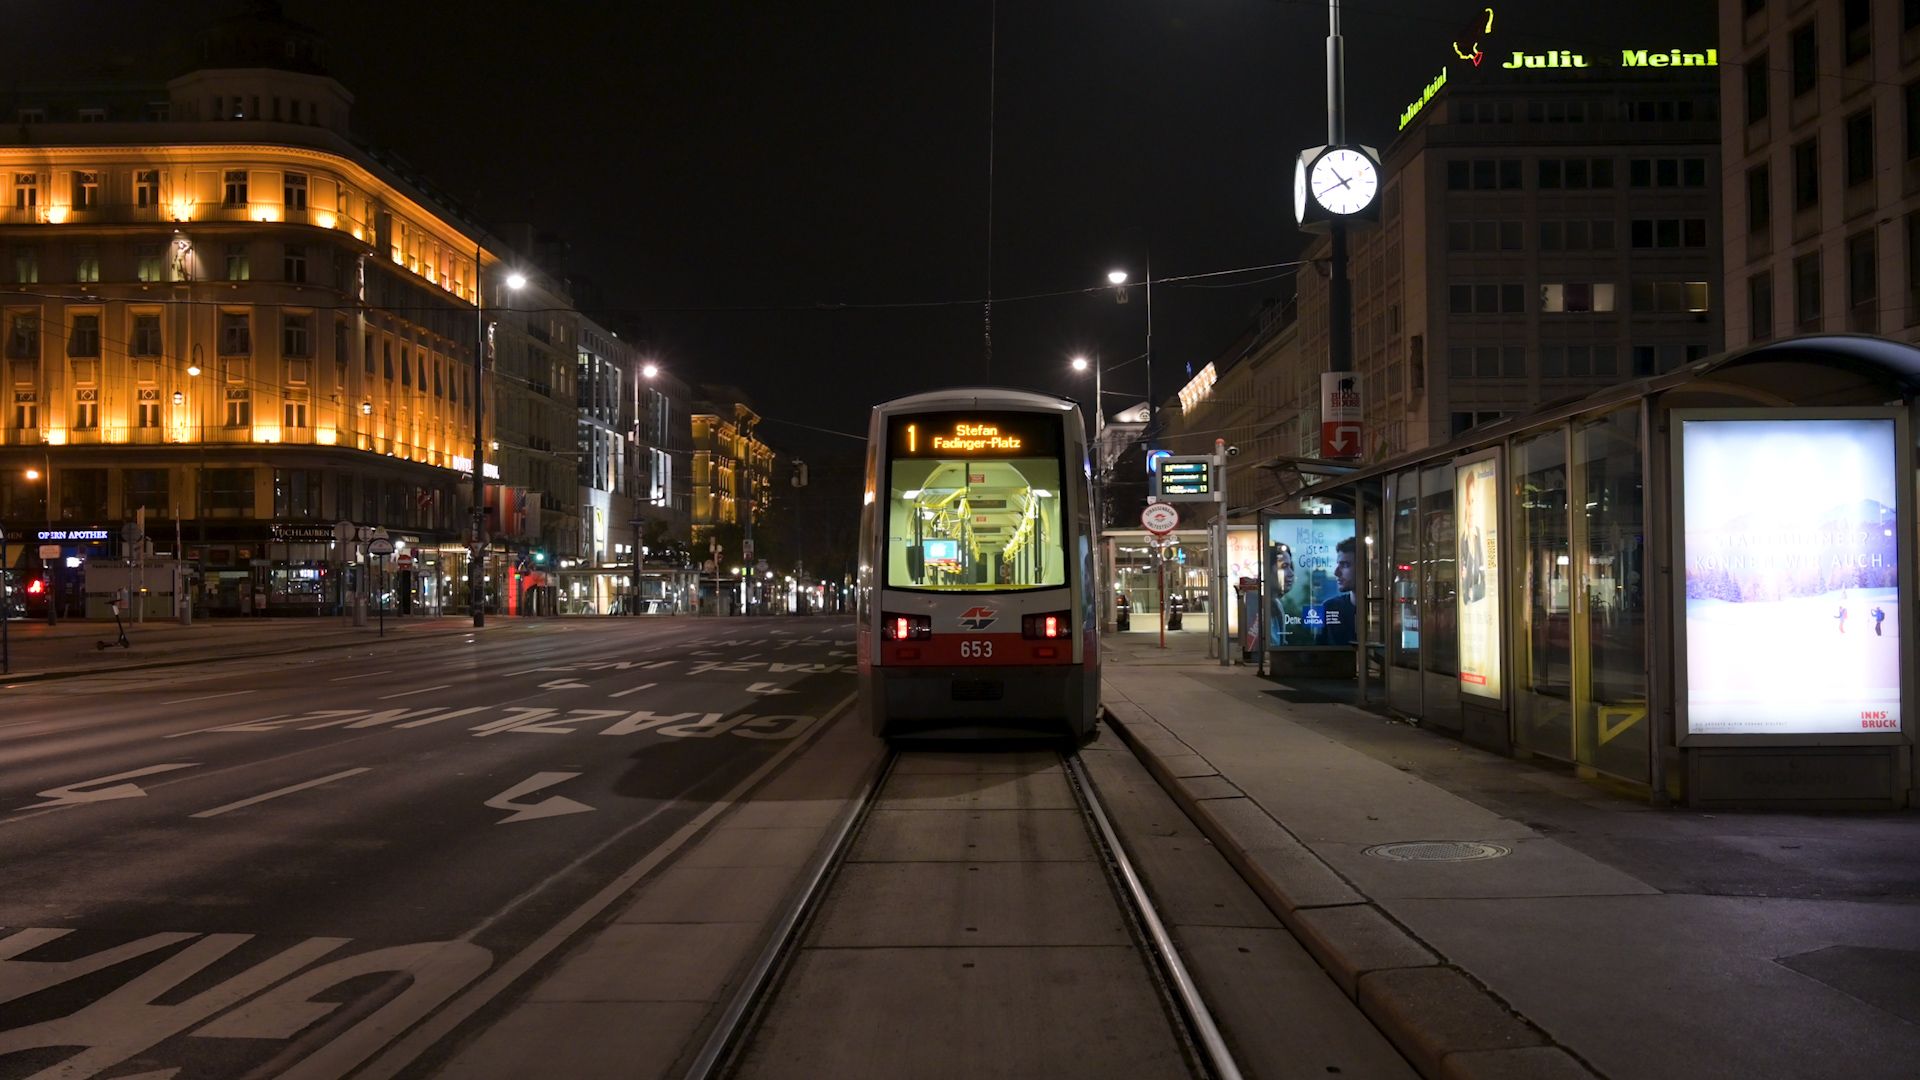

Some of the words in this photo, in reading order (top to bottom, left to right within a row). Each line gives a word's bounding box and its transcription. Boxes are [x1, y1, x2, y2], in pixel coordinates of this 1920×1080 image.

[1622, 48, 1718, 67] Meinl
[1399, 97, 1424, 131] Julius
[1423, 65, 1447, 105] Meinl
[1330, 400, 1361, 408] HOUSE
[956, 424, 998, 437] Stefan
[907, 425, 916, 452] 1
[934, 437, 1021, 451] Fadinger-Platz
[38, 531, 67, 539] OPERN
[274, 529, 330, 537] TUCHLAUBEN
[1306, 544, 1318, 555] ist
[1785, 553, 1823, 568] WIR
[1831, 553, 1892, 568] AUCH.
[1284, 614, 1302, 625] Denk
[960, 640, 993, 658] 653
[203, 705, 559, 733] LINZ
[503, 708, 818, 740] GRAZ
[1861, 719, 1897, 728] BRUCK
